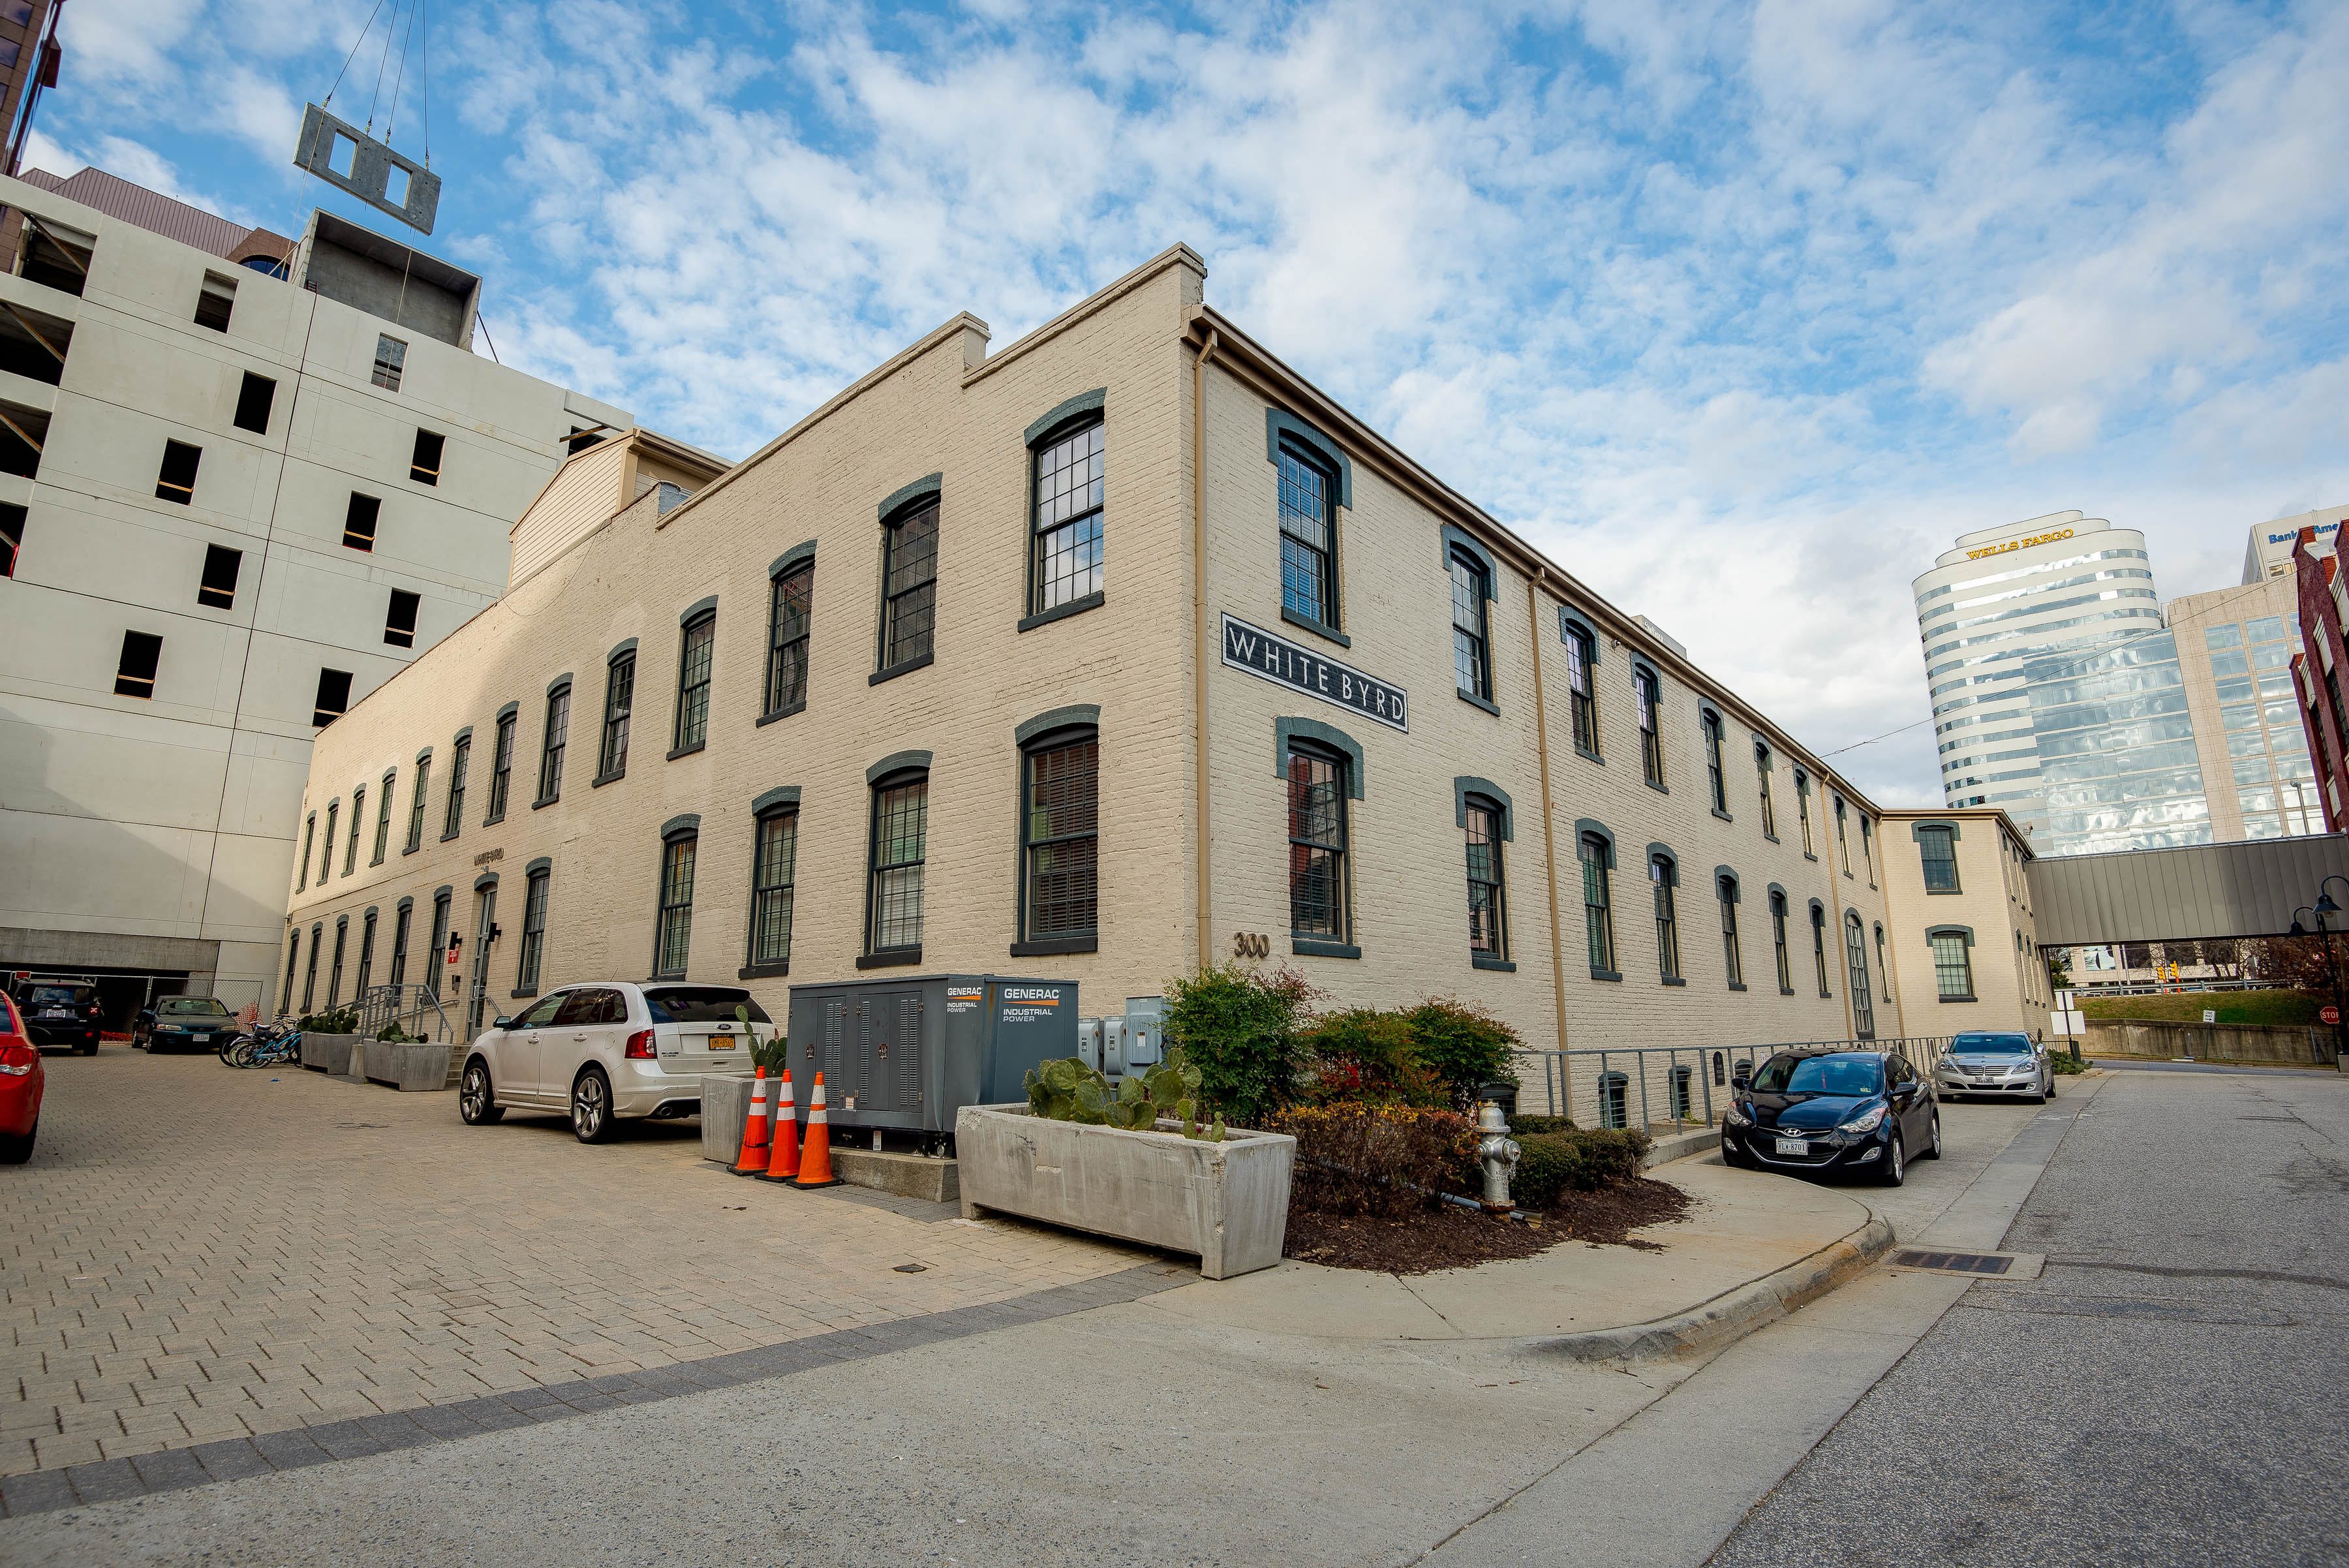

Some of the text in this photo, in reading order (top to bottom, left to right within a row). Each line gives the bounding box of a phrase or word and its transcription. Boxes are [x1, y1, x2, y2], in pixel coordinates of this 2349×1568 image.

[1967, 529, 2074, 559] WELLS FARGO
[2268, 530, 2298, 544] Bank
[1229, 626, 1404, 720] WHITE BYRD
[1234, 932, 1270, 957] 300
[947, 987, 983, 996] GENERAC
[1004, 988, 1060, 999] GENERAC
